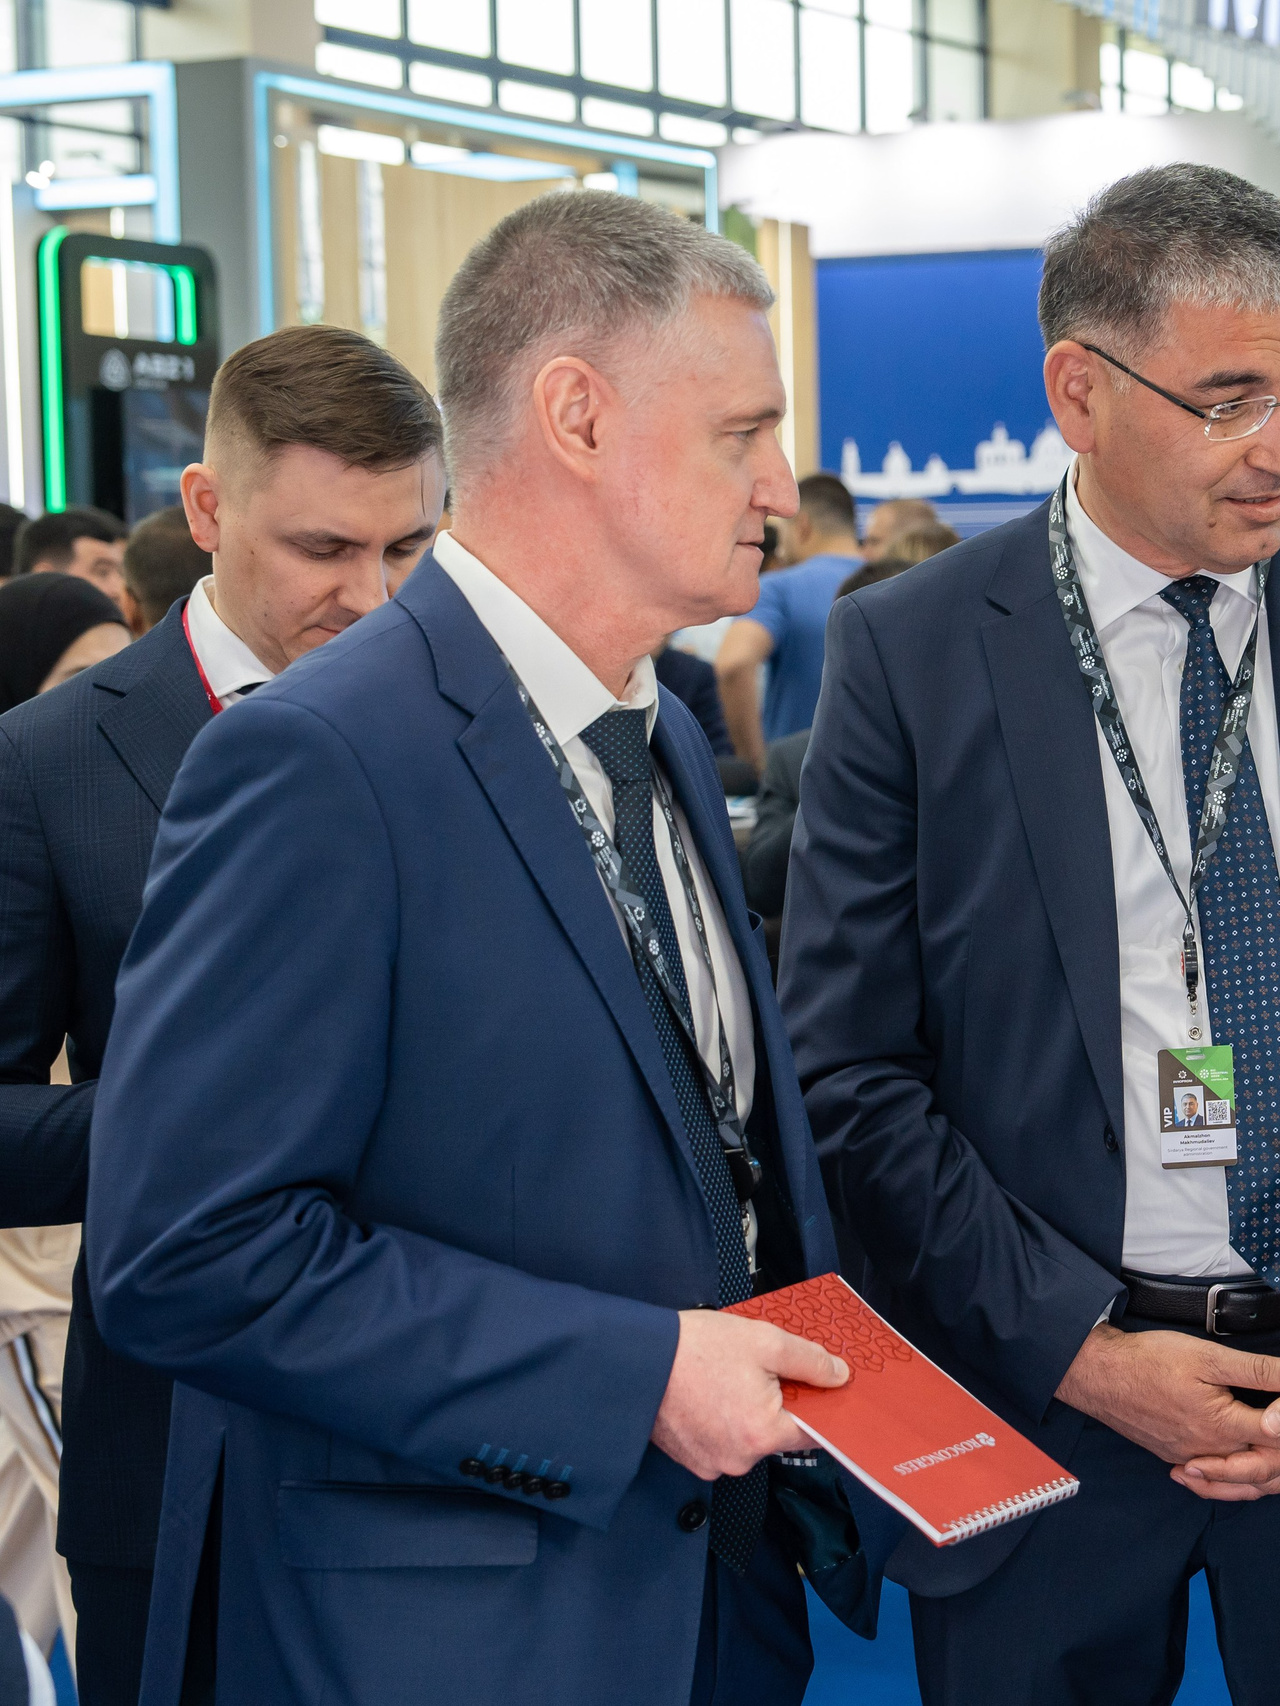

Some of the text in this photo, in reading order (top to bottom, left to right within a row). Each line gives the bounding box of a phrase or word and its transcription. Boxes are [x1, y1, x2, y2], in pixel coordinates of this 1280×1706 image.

[1072, 584, 1081, 609] INNOPROM
[1078, 631, 1086, 654] INDUSTRIAL
[1099, 673, 1110, 699] INNOPROM
[623, 903, 641, 932] INNOPROM
[1164, 1107, 1172, 1128] VIP
[894, 1438, 981, 1476] ROSCONGRESS
